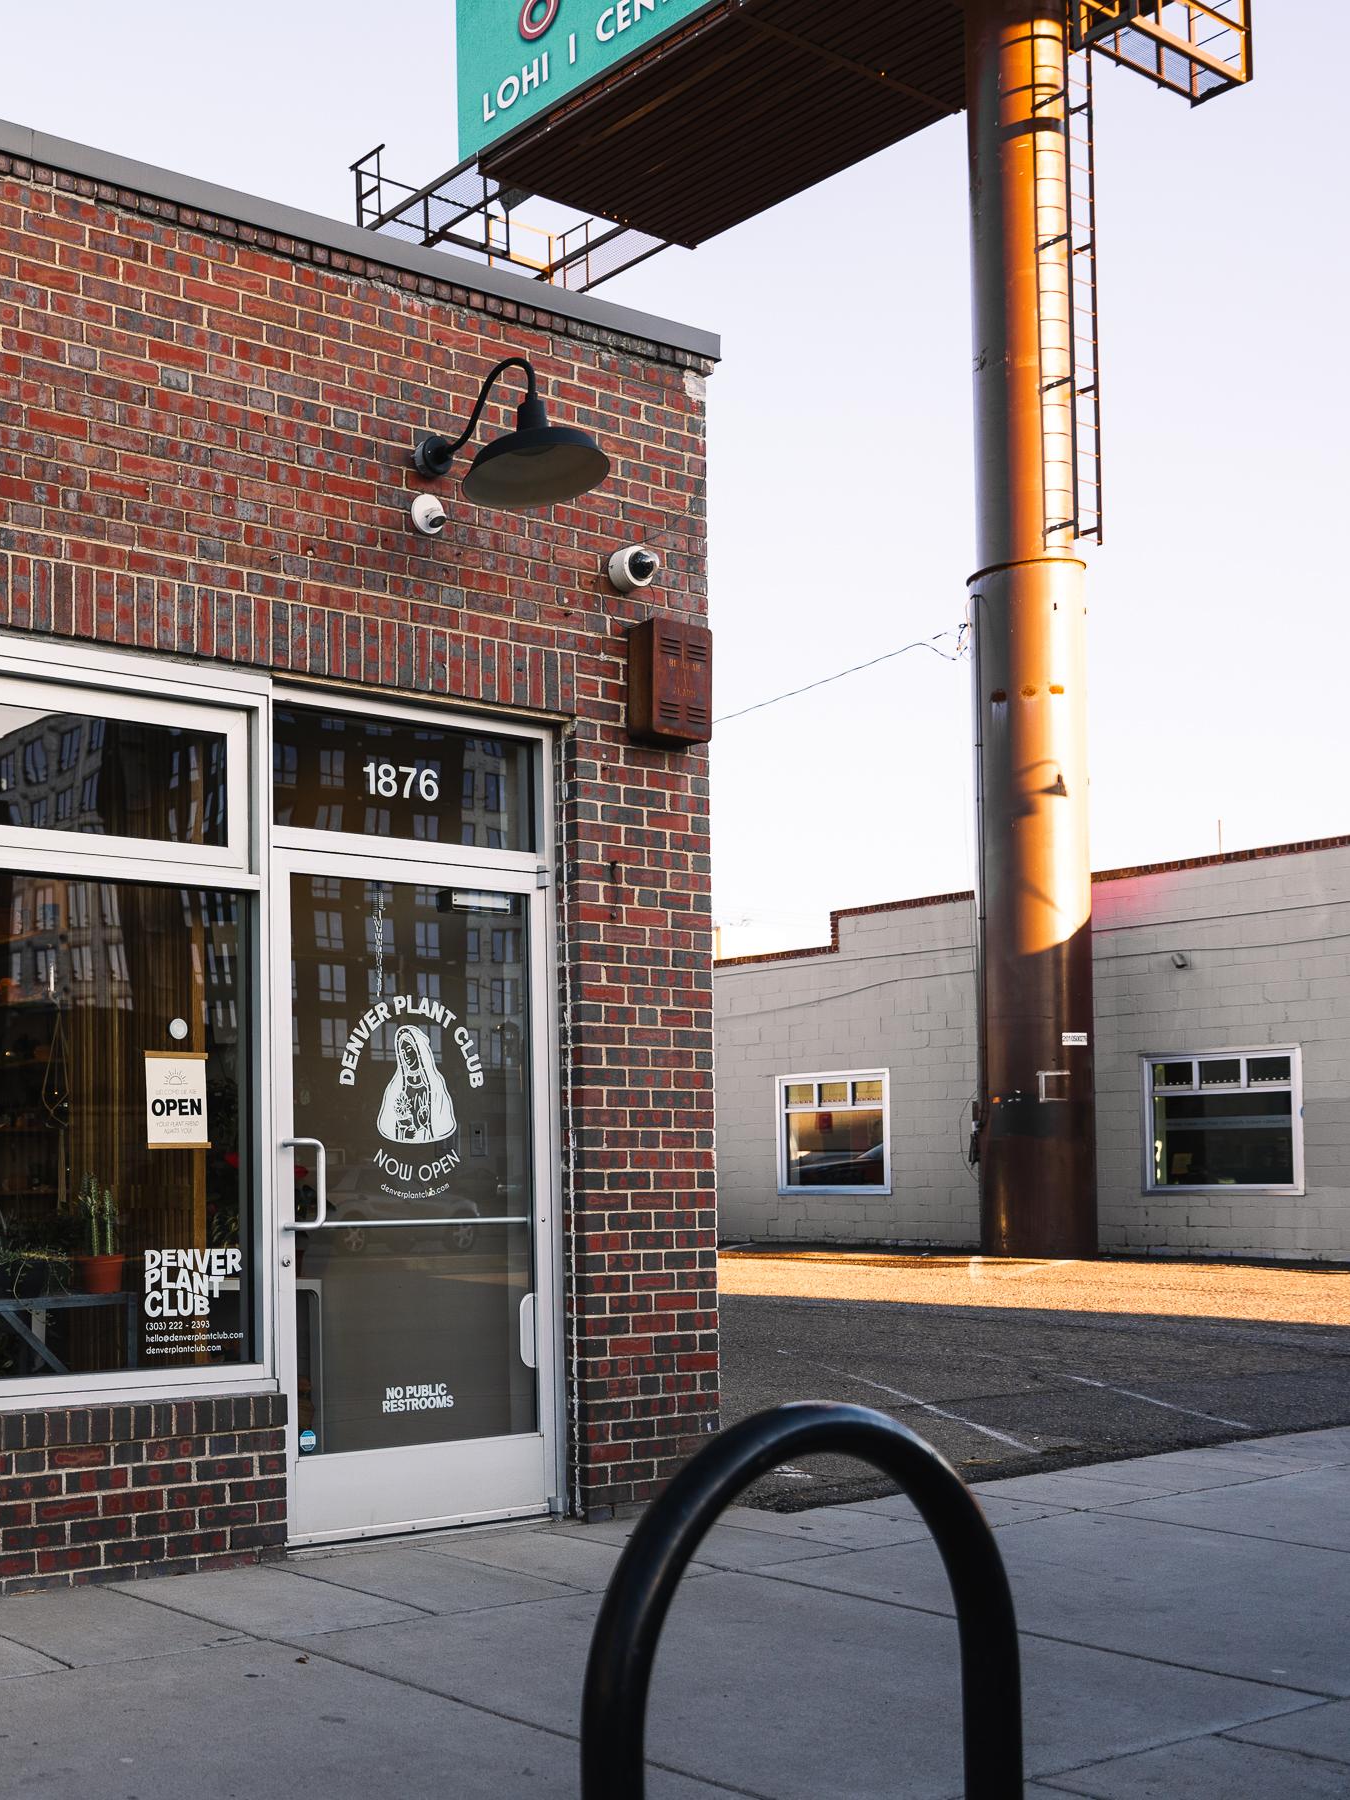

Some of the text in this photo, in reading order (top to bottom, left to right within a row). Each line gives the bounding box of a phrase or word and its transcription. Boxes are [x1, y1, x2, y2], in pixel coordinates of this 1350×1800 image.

[482, 51, 550, 123] LOHI
[595, 0, 668, 42] CEN
[362, 762, 439, 802] 1876
[339, 994, 485, 1089] DENVER PLANT CLUB
[152, 1099, 202, 1116] OPEN
[373, 1148, 460, 1182] NOW OPEN
[380, 1182, 450, 1200] denverplantclub.com
[144, 1248, 243, 1276] DENVER
[144, 1266, 225, 1298] PLANT
[144, 1289, 211, 1318] CLUB
[145, 1321, 166, 1331] (303)
[168, 1321, 183, 1330] 222
[191, 1320, 210, 1329] 2393
[145, 1331, 244, 1343] hello@denverplantclub.com
[145, 1343, 222, 1355] denverplantclub.com
[385, 1383, 447, 1400] NO PUBLIC
[382, 1395, 454, 1413] RESTROOMS
